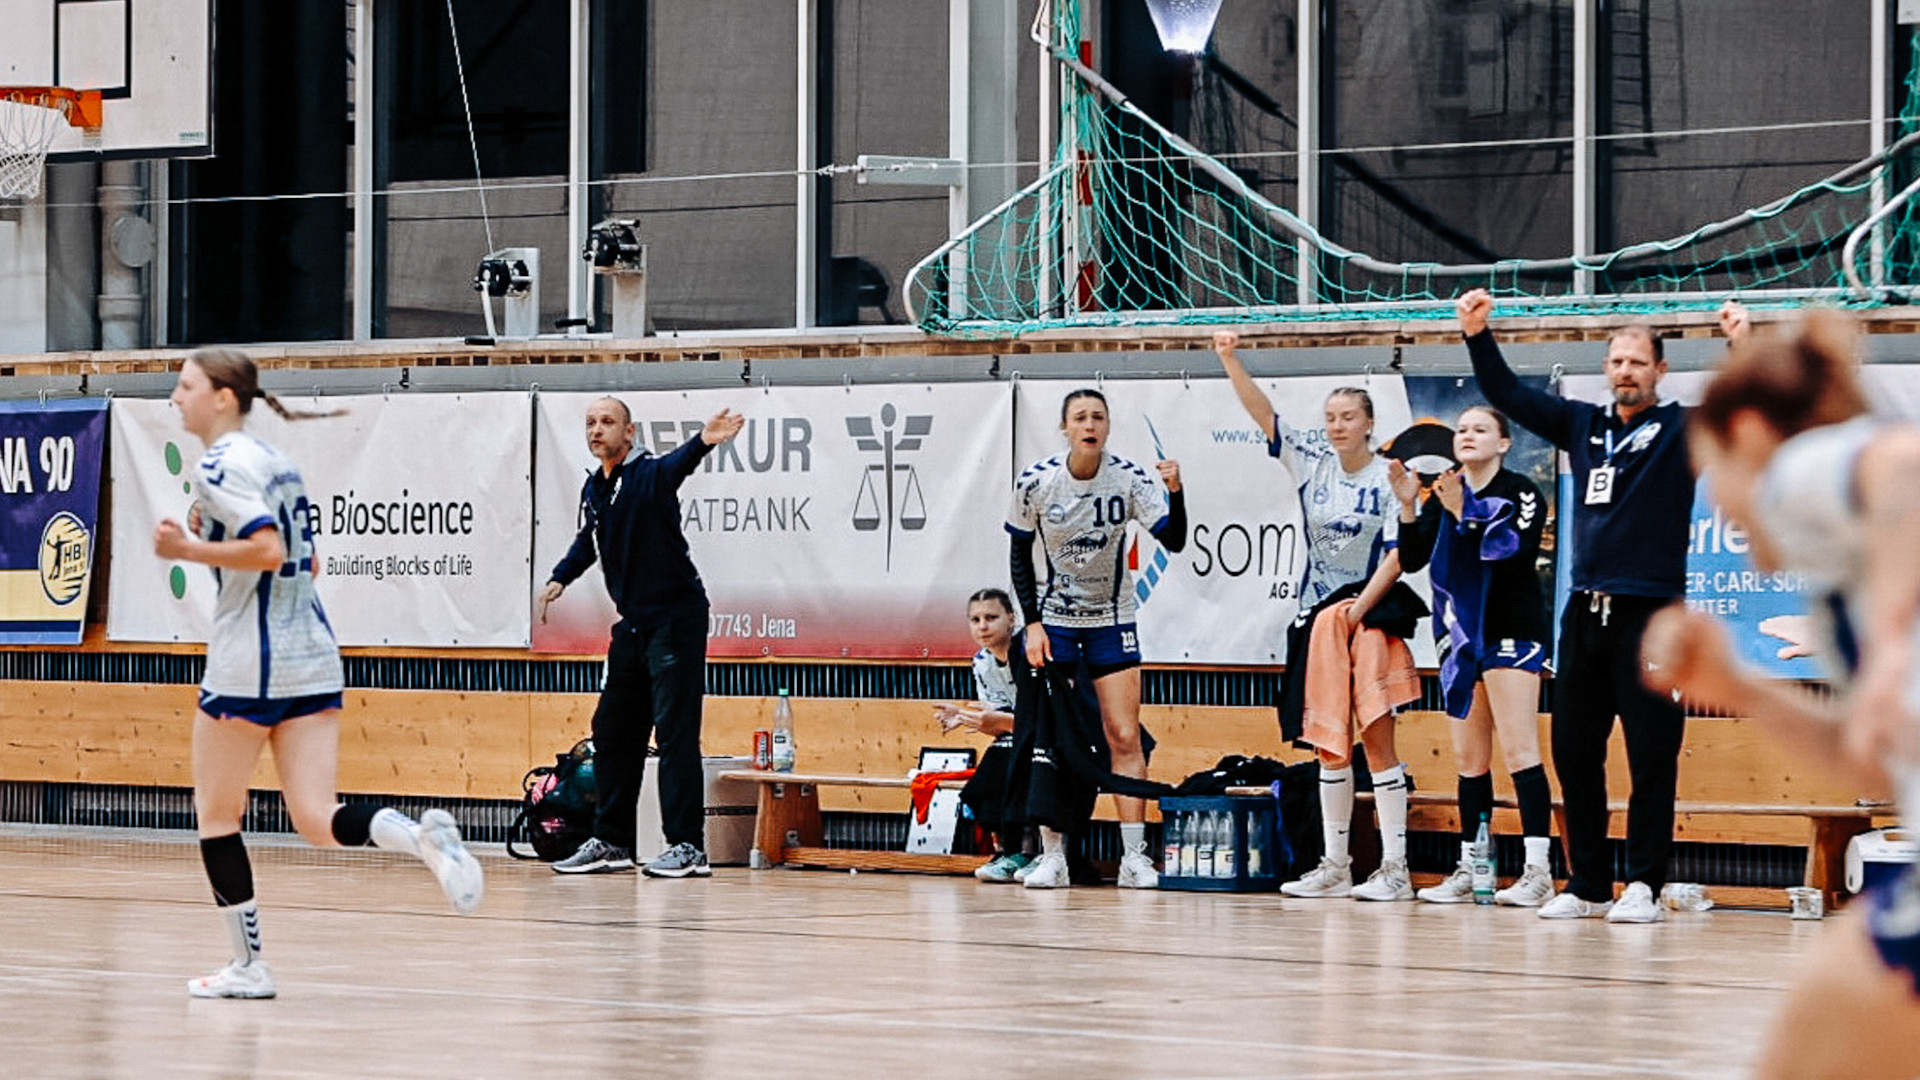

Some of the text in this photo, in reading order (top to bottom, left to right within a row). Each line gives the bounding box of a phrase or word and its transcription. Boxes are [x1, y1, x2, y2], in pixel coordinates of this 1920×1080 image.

[634, 418, 812, 473] ERKUR
[39, 435, 75, 492] 90
[1593, 472, 1609, 493] B
[331, 489, 474, 535] Bioscience
[681, 497, 811, 532] ATBANK
[1093, 495, 1125, 527] 10
[1354, 487, 1380, 516] 11
[1192, 523, 1296, 577] som
[327, 555, 473, 580] Building Blocks of Life
[1269, 581, 1289, 599] AG
[757, 613, 796, 638] Jena
